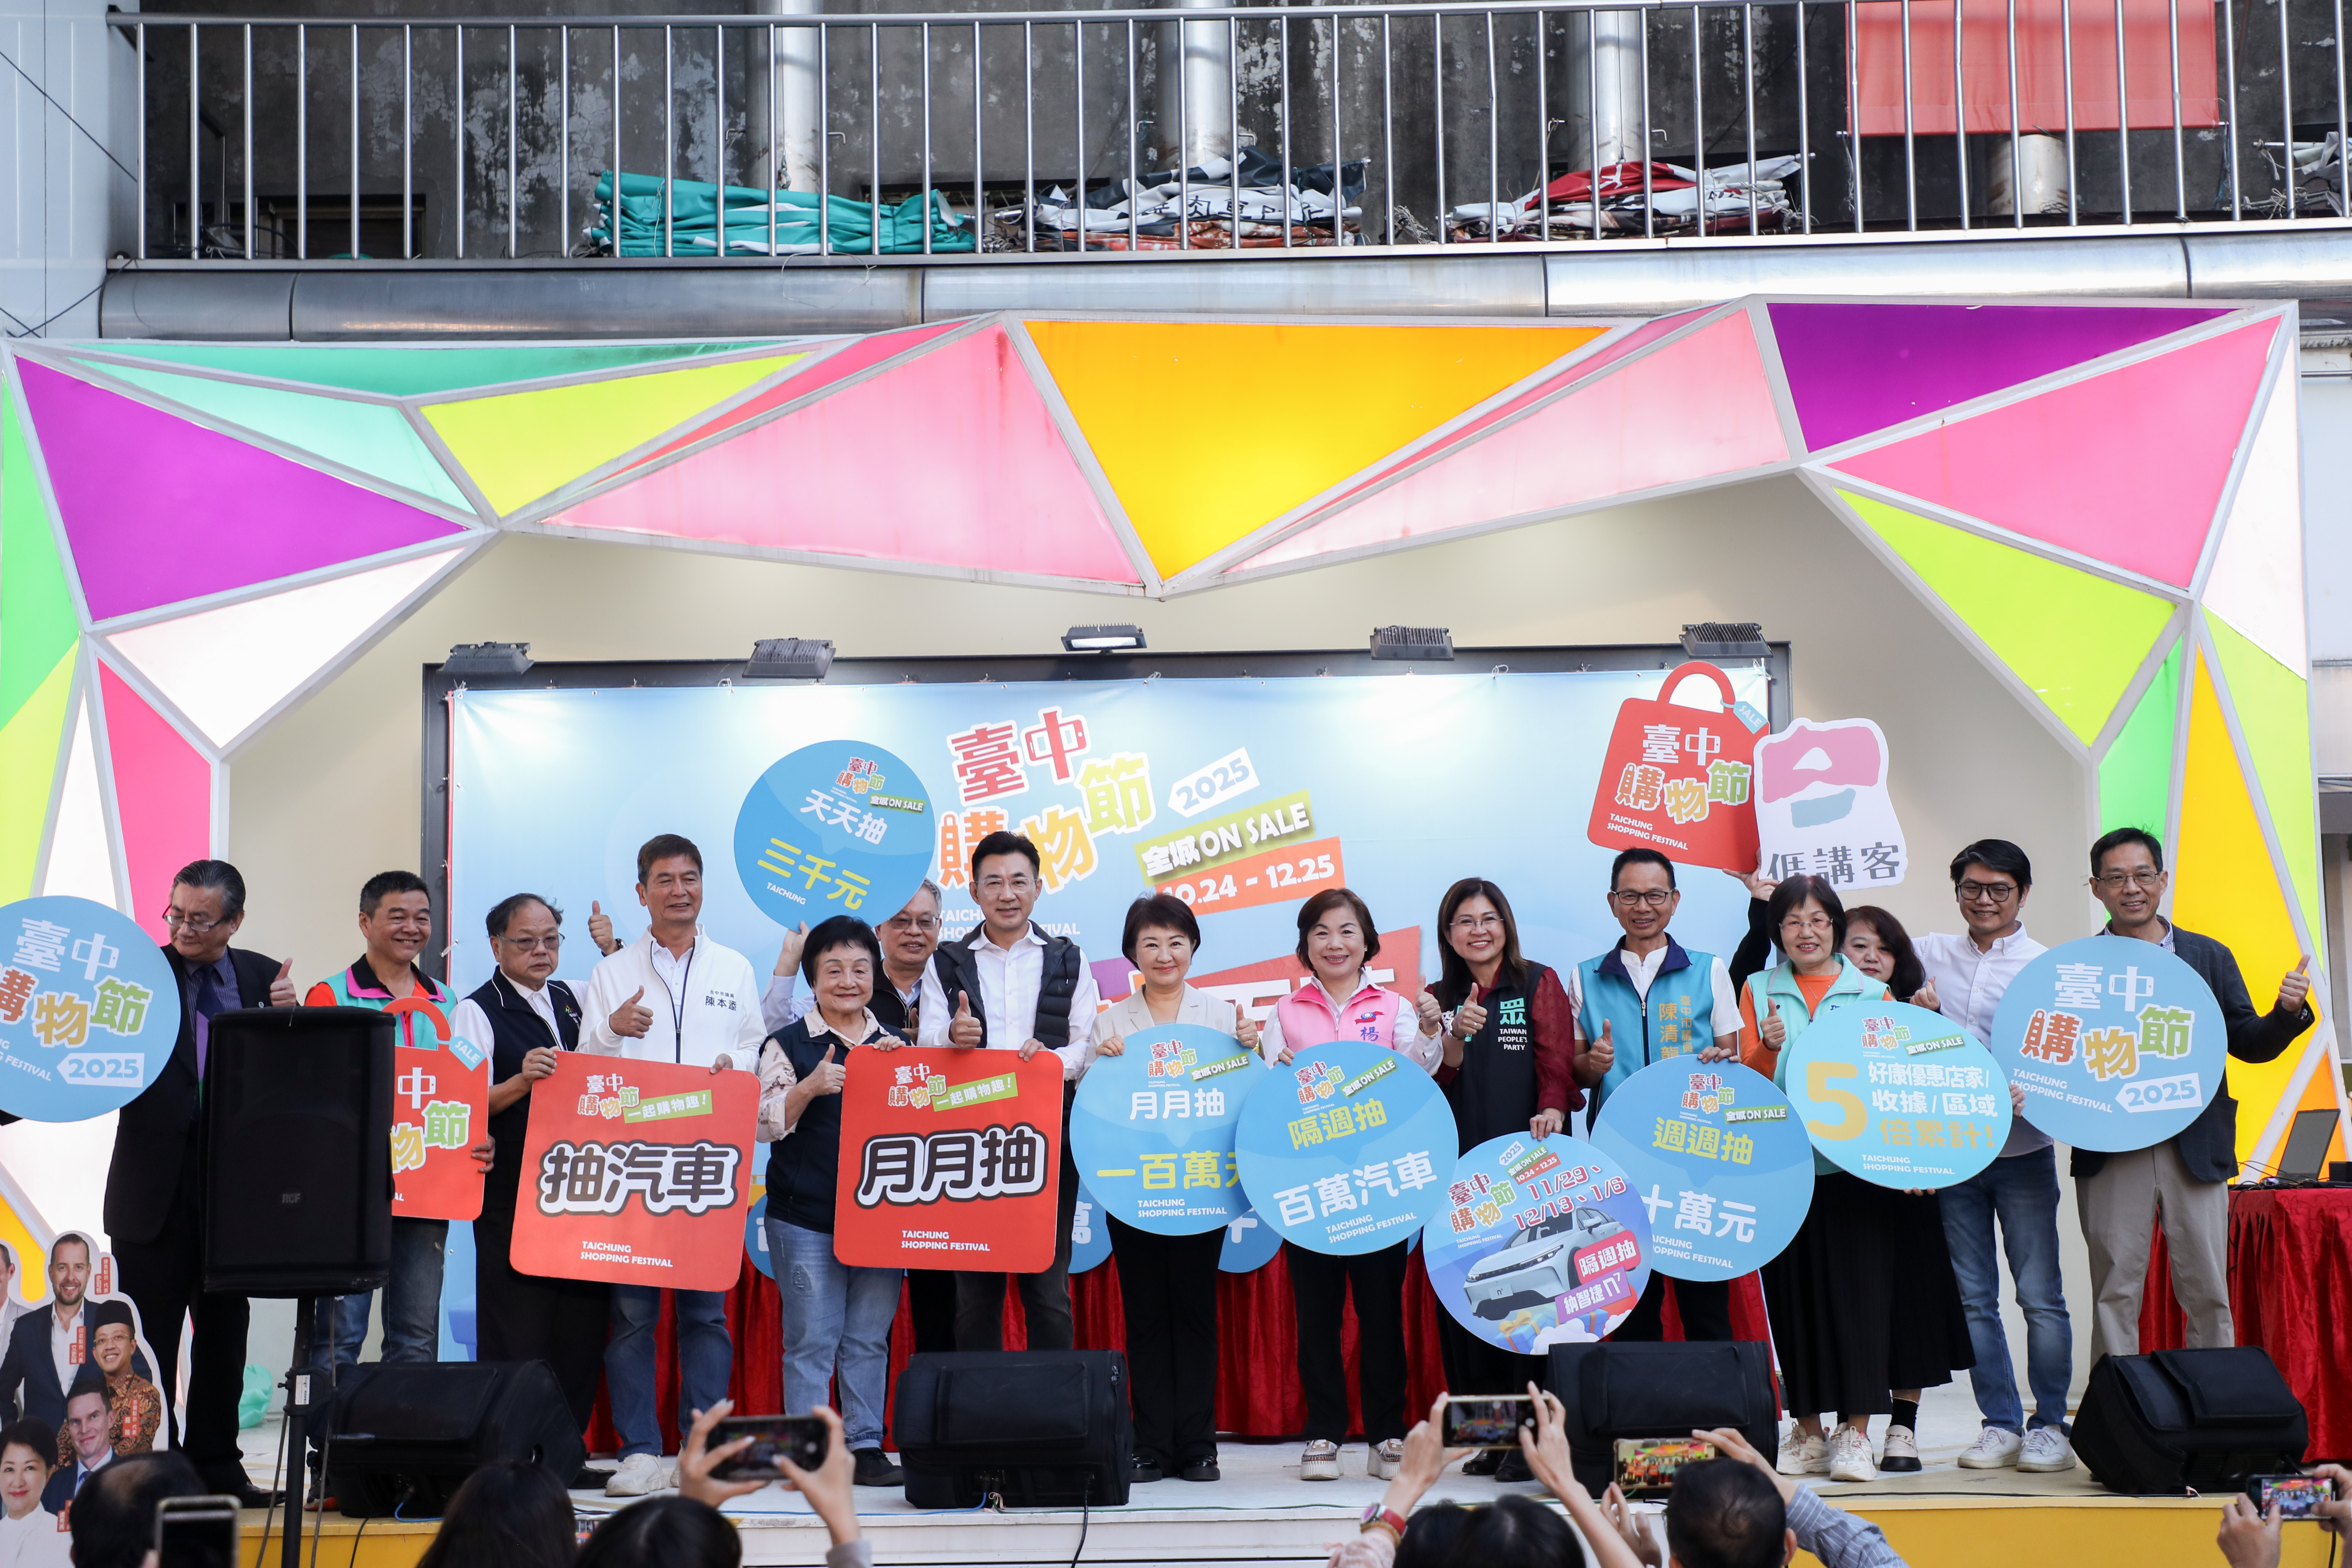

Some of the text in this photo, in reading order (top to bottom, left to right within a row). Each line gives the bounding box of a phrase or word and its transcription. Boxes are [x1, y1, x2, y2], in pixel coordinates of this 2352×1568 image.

[1739, 705, 1762, 727] SALE
[947, 706, 1091, 806] 臺中
[1642, 724, 1721, 766] 臺中
[847, 757, 878, 775] 臺中
[835, 770, 885, 794] 購物節
[1176, 758, 1250, 810] 2025
[1614, 758, 1752, 824] 購物節
[800, 789, 887, 845] 天天抽
[903, 801, 924, 812] SALE
[1249, 802, 1310, 845] SALE
[1610, 813, 1653, 831] TAICHUNG
[1607, 822, 1688, 850] SHOPPING FESTIVAL
[757, 837, 870, 910] 三千元
[1266, 854, 1335, 889] 12.25
[767, 882, 806, 905] TAICHUNG
[941, 908, 986, 922] TAICH
[12, 917, 120, 981] 臺中
[2054, 963, 2154, 1012] 臺中
[705, 995, 737, 1011] 陳本添
[1360, 1026, 1379, 1042] 楊
[1680, 995, 1694, 1053] 臺中市議員
[1862, 1016, 1895, 1032] 臺中
[1150, 1039, 1182, 1060] 臺中
[1861, 1026, 1911, 1050] 購物節
[1941, 1037, 1964, 1048] SALE
[2019, 1003, 2195, 1082] 購物節
[455, 1040, 480, 1063] SALE
[1148, 1048, 1198, 1078] 購物節
[1226, 1056, 1249, 1069] SALE
[5, 1054, 52, 1082] FESTIVAL
[68, 1058, 140, 1079] 2025
[894, 1063, 930, 1085] 臺中
[1294, 1061, 1327, 1086] 臺中
[1374, 1060, 1396, 1077] SALE
[2013, 1068, 2068, 1089] TAICHUNG
[586, 1073, 624, 1093] 臺中
[888, 1074, 947, 1109] 購物節
[1297, 1065, 1345, 1104] 購物節
[1689, 1073, 1722, 1091] 臺中
[2125, 1079, 2197, 1107] 2025
[577, 1086, 640, 1120] 購物節
[1129, 1087, 1225, 1120] 月月抽
[1681, 1087, 1735, 1114] 購物節
[1806, 1060, 1868, 1141] 5
[2066, 1093, 2113, 1113] FESTIVAL
[1287, 1098, 1387, 1150] 隔週抽
[1763, 1108, 1786, 1119] SALE
[390, 1100, 471, 1174] 物節
[1652, 1116, 1754, 1165] 週週抽
[1500, 1143, 1522, 1164] 2025
[1531, 1147, 1547, 1161] SALE
[1861, 1154, 1911, 1164] TAICHUNG
[858, 1126, 1045, 1206] 月月抽
[1515, 1169, 1535, 1183] 10.24
[1540, 1156, 1558, 1170] 12.25
[1863, 1163, 1955, 1175] SHOPPING FESTIVAL
[540, 1143, 738, 1214] 抽汽車
[1273, 1150, 1437, 1227] 百萬汽車
[1448, 1172, 1491, 1207] 臺中
[282, 1193, 301, 1203] RCF
[1138, 1198, 1185, 1208] TAICHUNG
[1450, 1180, 1517, 1234] 購物節
[1138, 1206, 1227, 1217] SHOPPING FESTIVAL
[1642, 1184, 1756, 1243] 十萬元
[902, 1230, 949, 1240] TAICHUNG
[1325, 1214, 1373, 1234] TAICHUNG
[1328, 1212, 1417, 1244] SHOPPING FESTIVAL
[582, 1241, 631, 1253] TAICHUNG
[901, 1240, 991, 1252] SHOPPING FESTIVAL
[1456, 1234, 1481, 1243] TAICHUNG
[1458, 1234, 1503, 1249] SHOPPING FESTIVAL
[1652, 1234, 1693, 1249] AICHUNG
[580, 1251, 673, 1268] SHOPPING FESTIVAL
[1578, 1239, 1636, 1277] 隔週抽
[1653, 1245, 1733, 1268] OPPING FESTIVAL
